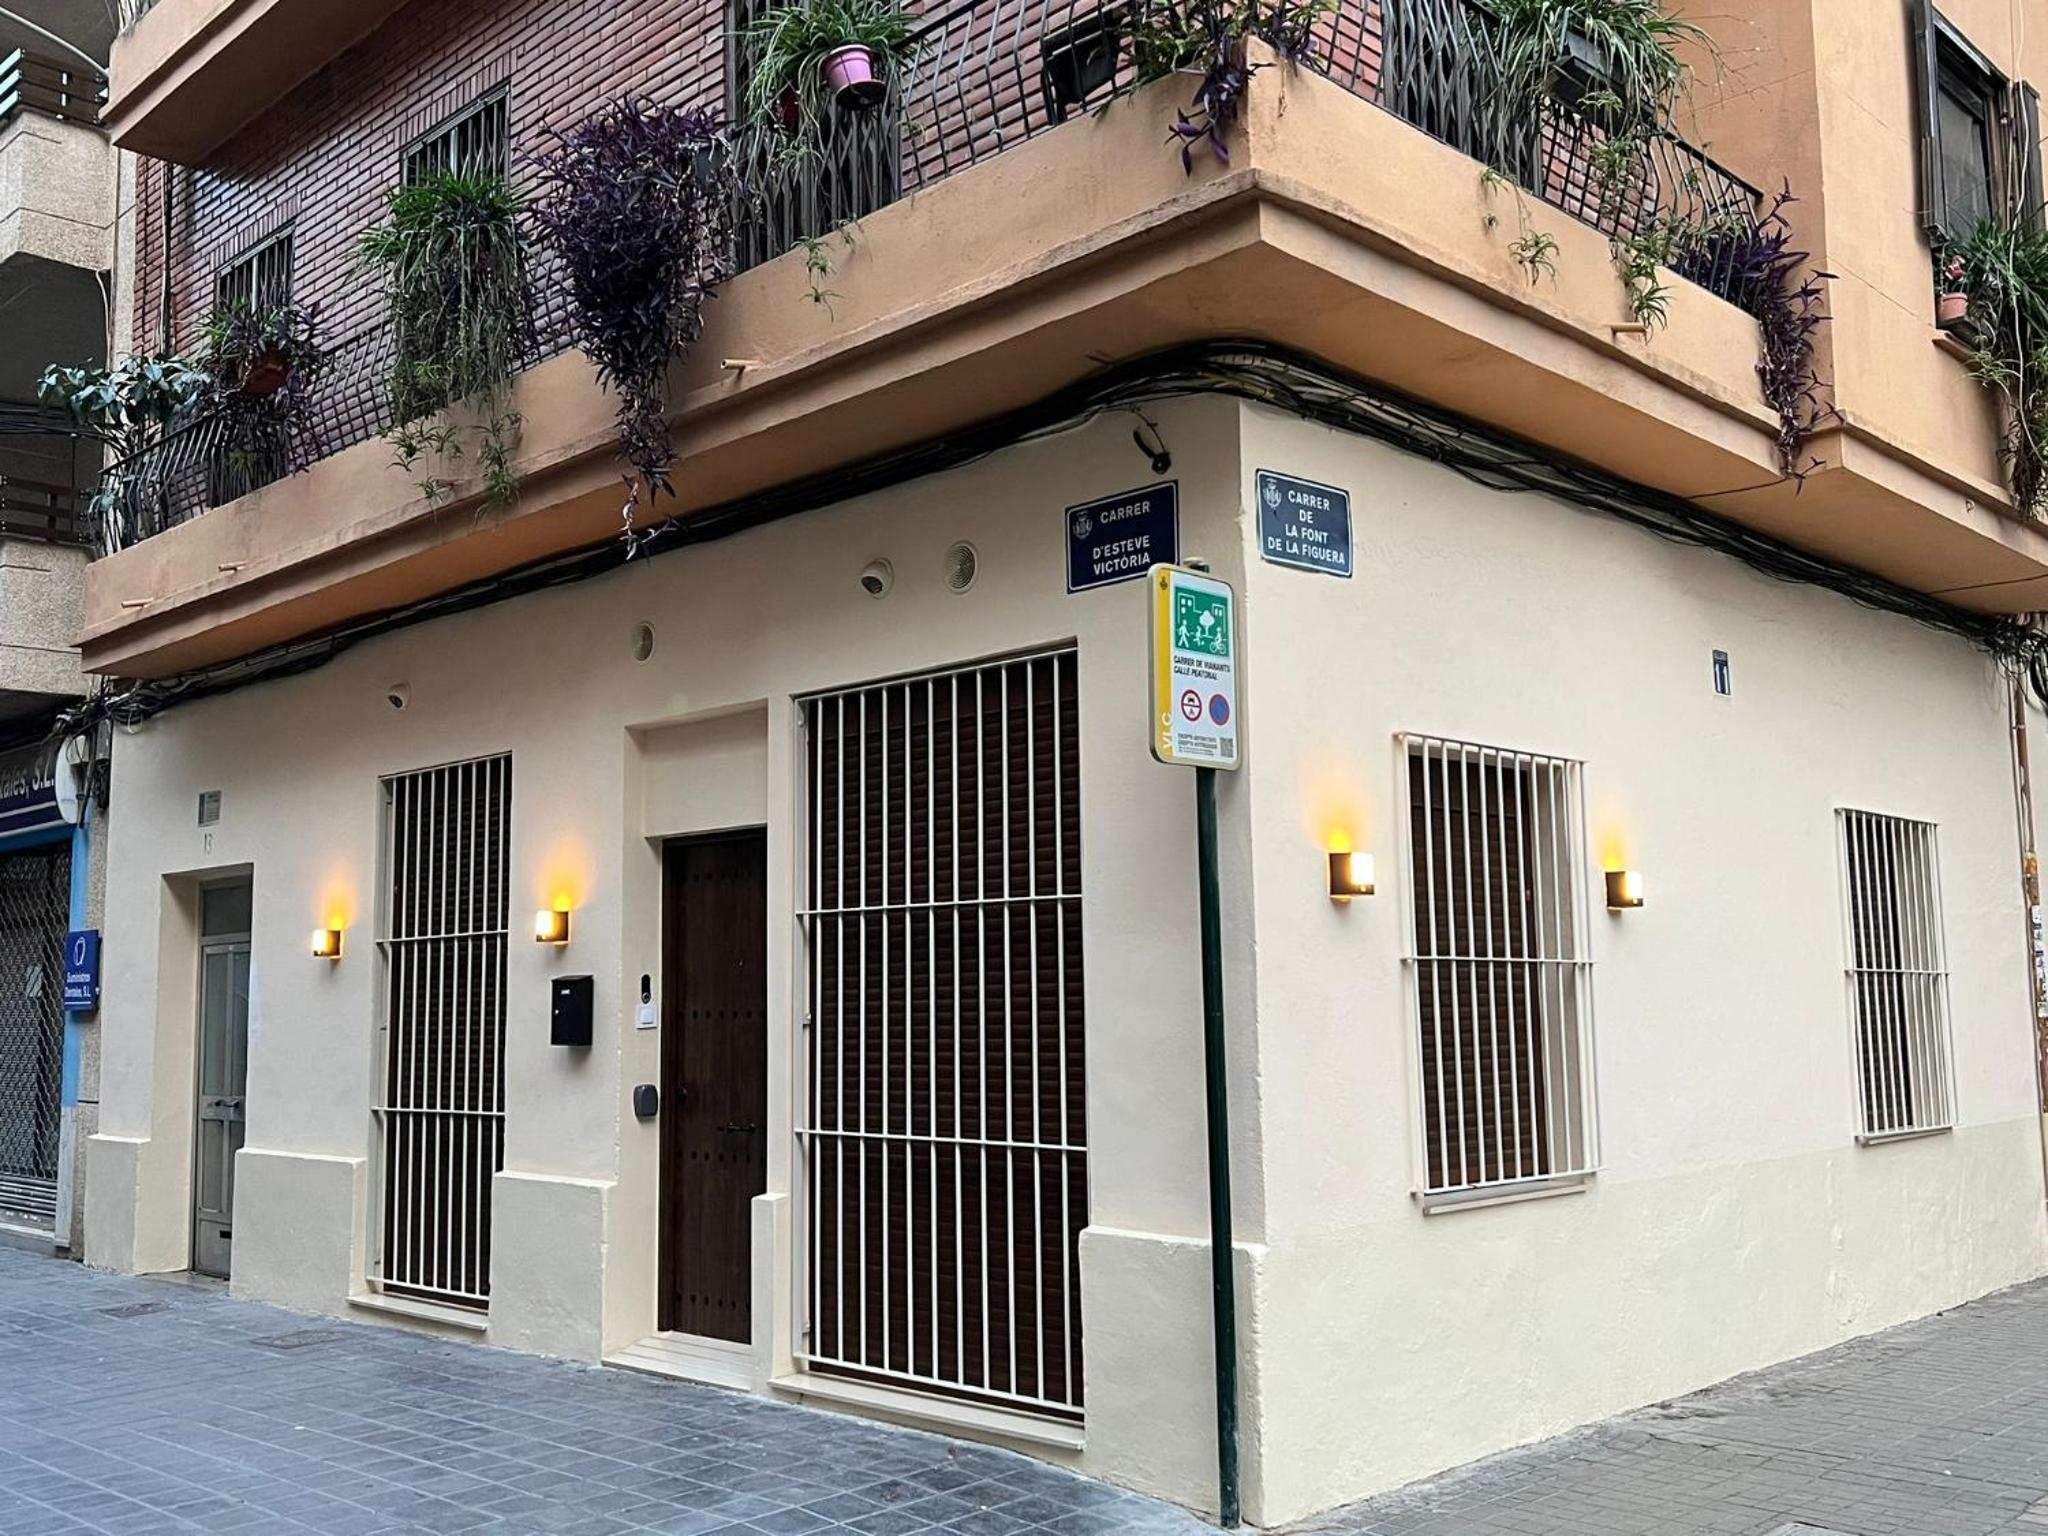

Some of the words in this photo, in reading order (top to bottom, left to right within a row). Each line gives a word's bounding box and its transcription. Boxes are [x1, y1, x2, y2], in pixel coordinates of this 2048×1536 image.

[1288, 490, 1330, 511] CARRER
[1100, 501, 1150, 523] CARRER
[1300, 509, 1314, 524] DE
[1285, 523, 1298, 538] LA
[1301, 527, 1328, 544] FONT
[1093, 535, 1150, 559] D'ESTEVE
[1268, 536, 1282, 551] DE
[1286, 540, 1299, 555] LA
[1302, 544, 1345, 564] FIGUERA
[1093, 552, 1150, 575] VICTÒRIA
